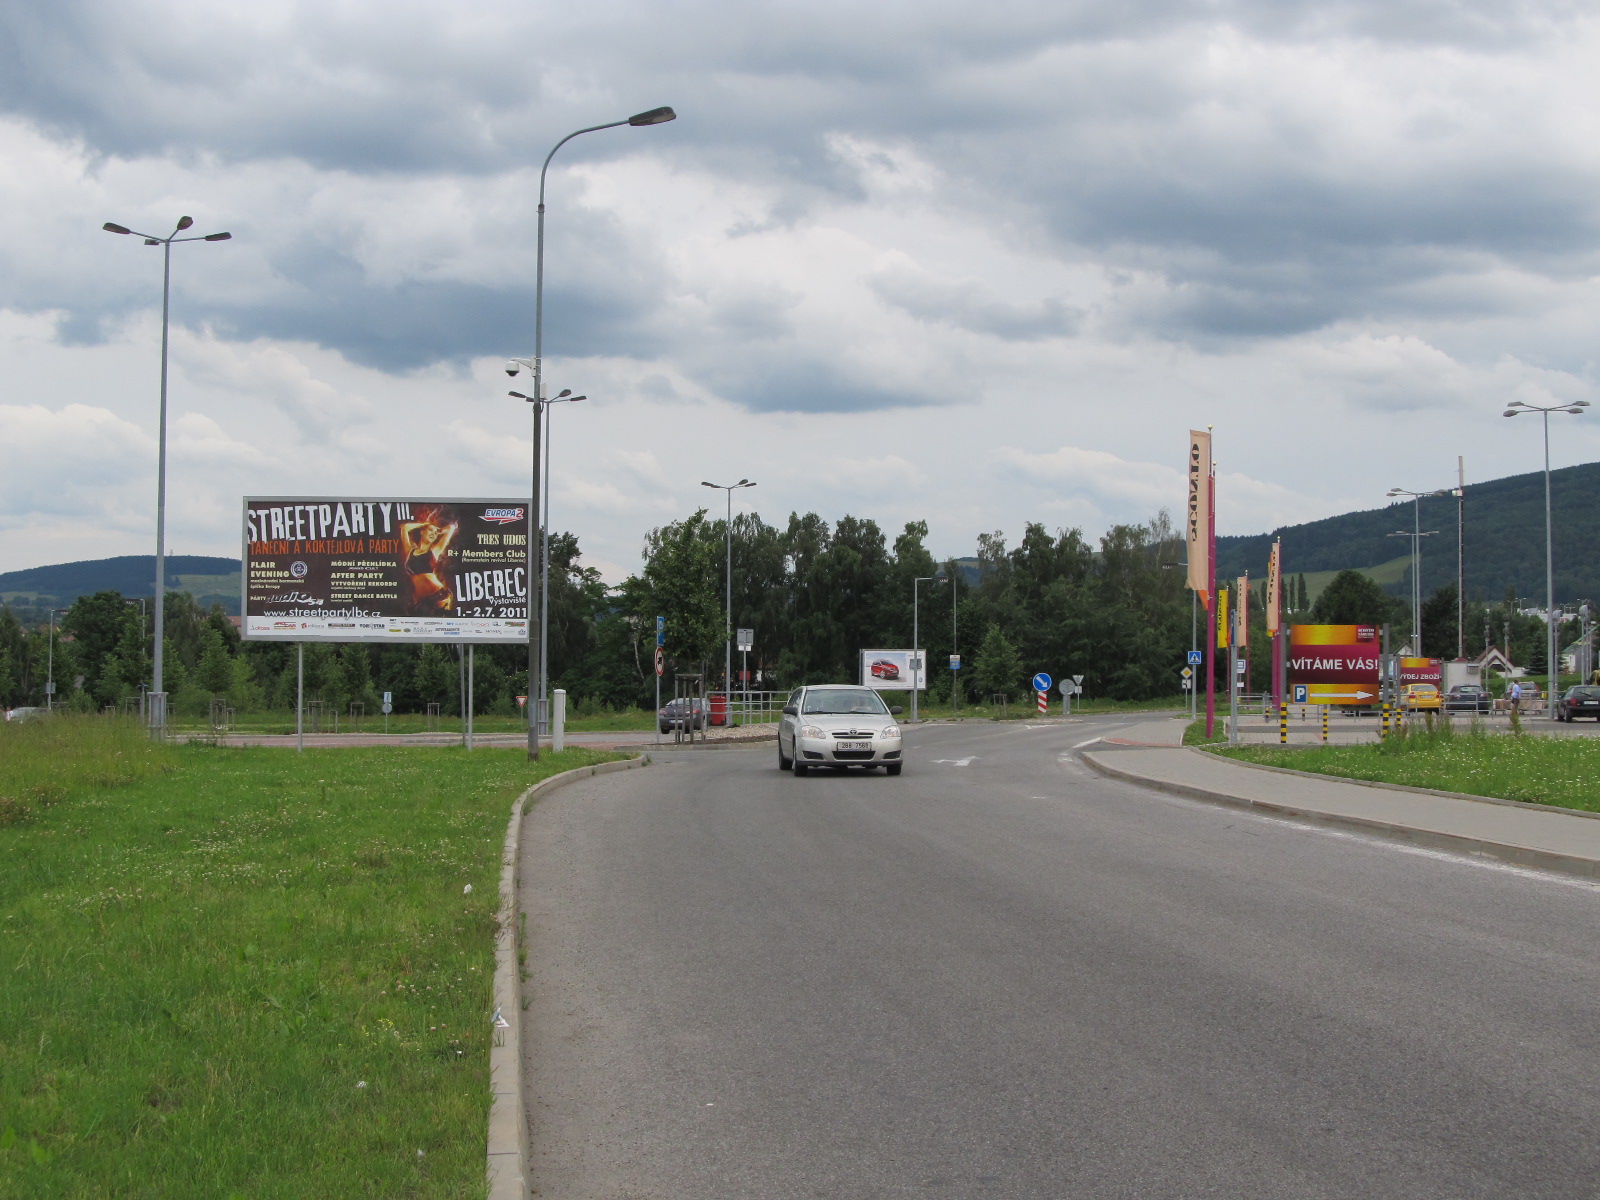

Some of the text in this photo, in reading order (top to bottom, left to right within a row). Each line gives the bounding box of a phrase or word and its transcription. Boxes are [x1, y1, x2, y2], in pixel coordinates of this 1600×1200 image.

[485, 508, 524, 518] EVROPA 2
[248, 502, 392, 545] STREETPARTY
[477, 534, 500, 545] TRES
[293, 540, 301, 554] A
[305, 537, 364, 555] KOKTEJLOVÁ
[369, 537, 399, 554] PÁRTY
[447, 549, 526, 557] R+ Members Club
[250, 561, 276, 569] FLAIR
[331, 559, 397, 567] MÓDNÍ PŘEHLÍDKA
[250, 570, 290, 578] EVENING
[455, 567, 527, 602] LIBEREC
[489, 596, 527, 606] Výstaviště
[263, 606, 381, 620] www.streetpartylbc.cz
[499, 607, 527, 618] 2011
[1292, 656, 1378, 670] VÍTÁME VÁS!
[1296, 687, 1305, 700] P
